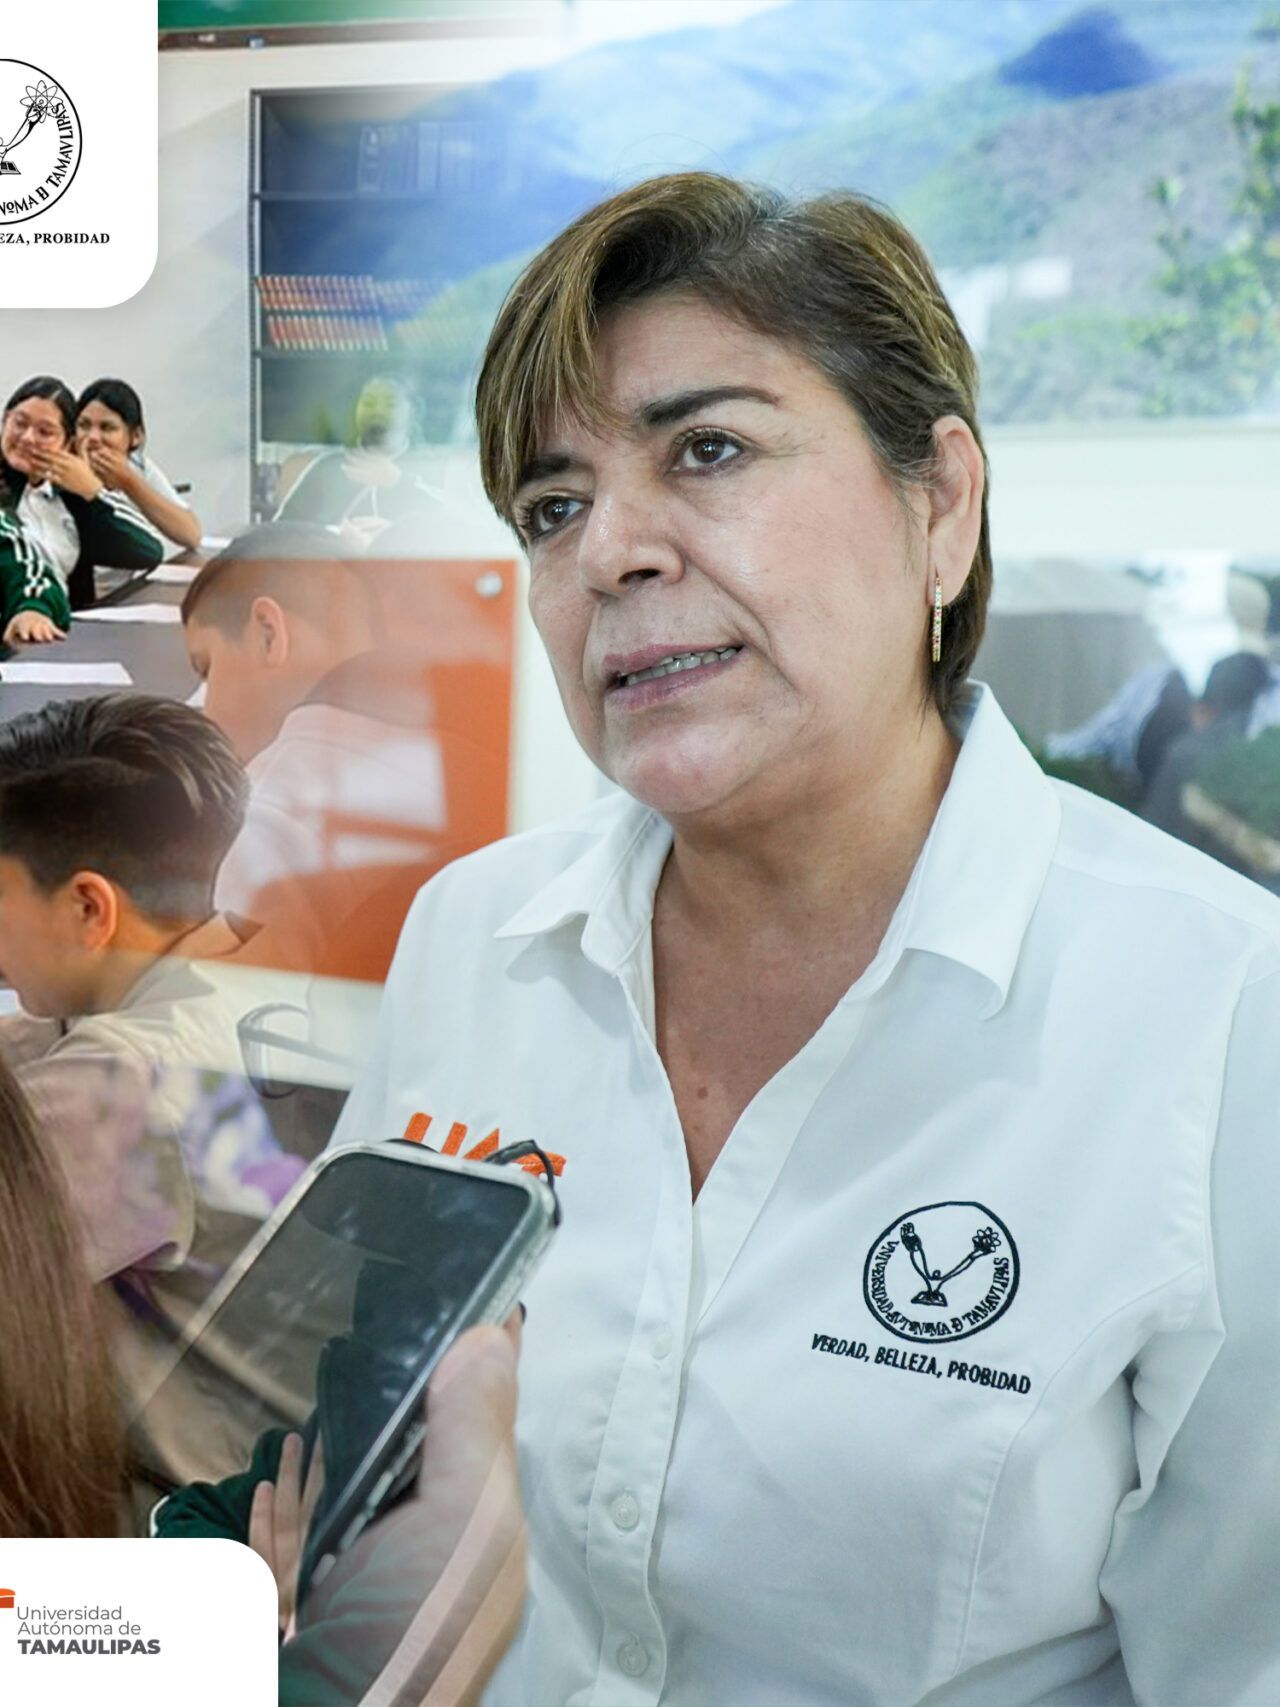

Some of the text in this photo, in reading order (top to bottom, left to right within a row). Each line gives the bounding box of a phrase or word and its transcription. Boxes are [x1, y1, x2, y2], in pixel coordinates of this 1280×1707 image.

[811, 1332, 1032, 1395] VERDAD, BELLEZA, PROBIDAD
